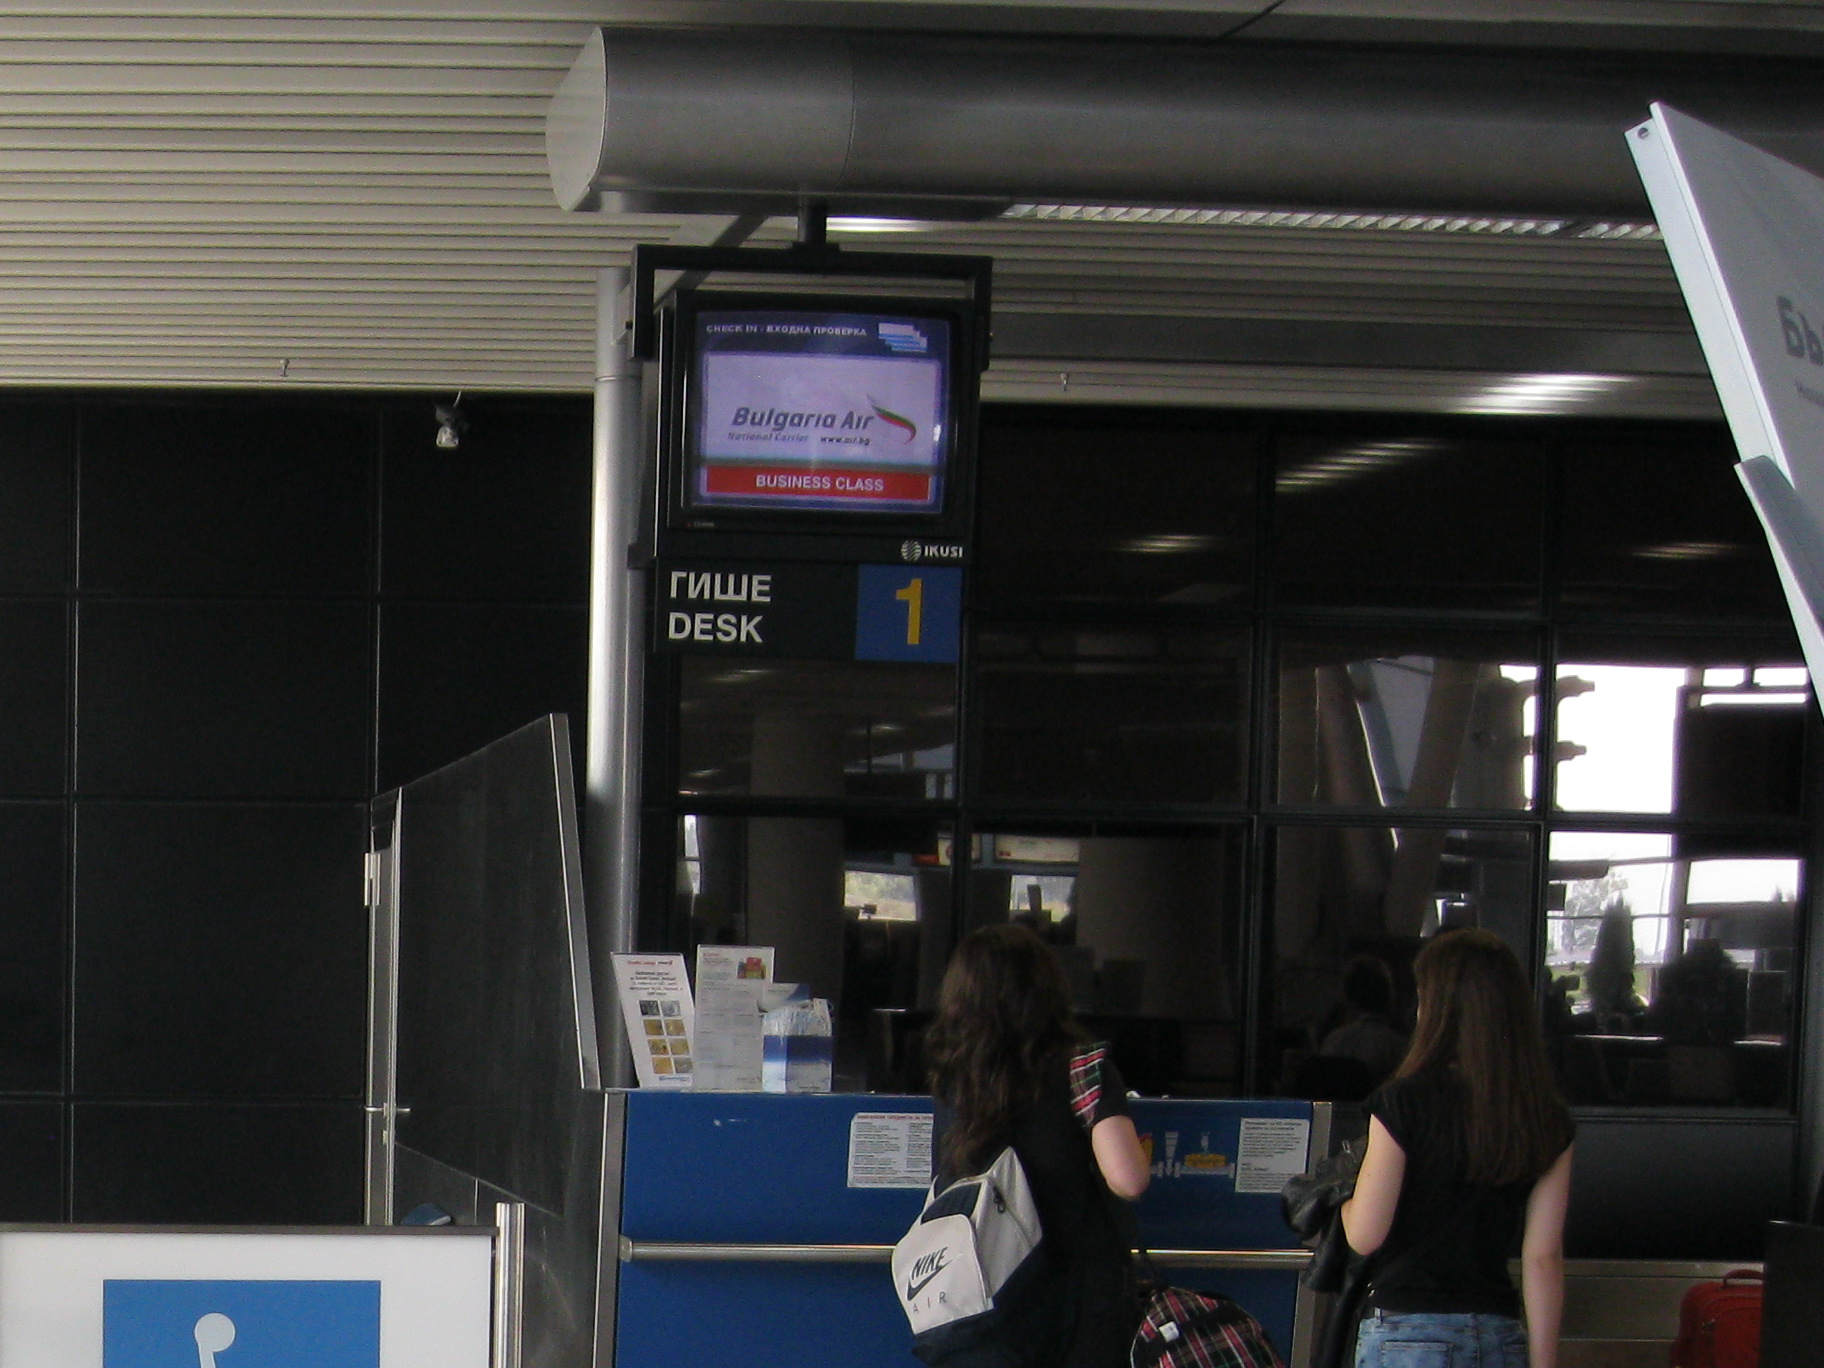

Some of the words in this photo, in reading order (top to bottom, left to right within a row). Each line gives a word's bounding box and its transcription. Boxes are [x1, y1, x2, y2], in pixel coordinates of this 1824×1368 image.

[706, 324, 743, 334] CHECK
[745, 325, 758, 334] IN
[766, 325, 811, 335] ВХОДНА
[813, 326, 867, 337] ПРОВЕРКА
[731, 406, 836, 431] Bulgaria
[841, 410, 874, 430] Air
[727, 431, 773, 442] National
[774, 431, 809, 443] Carrier
[820, 434, 870, 446] www.air.bg
[756, 474, 831, 489] BUSINESS
[835, 475, 884, 491] CLASS
[924, 545, 963, 559] IKUSI
[670, 571, 772, 602] ГИШЕ
[895, 578, 922, 645] 1
[668, 611, 763, 643] DESK
[912, 1245, 948, 1280] NIKE
